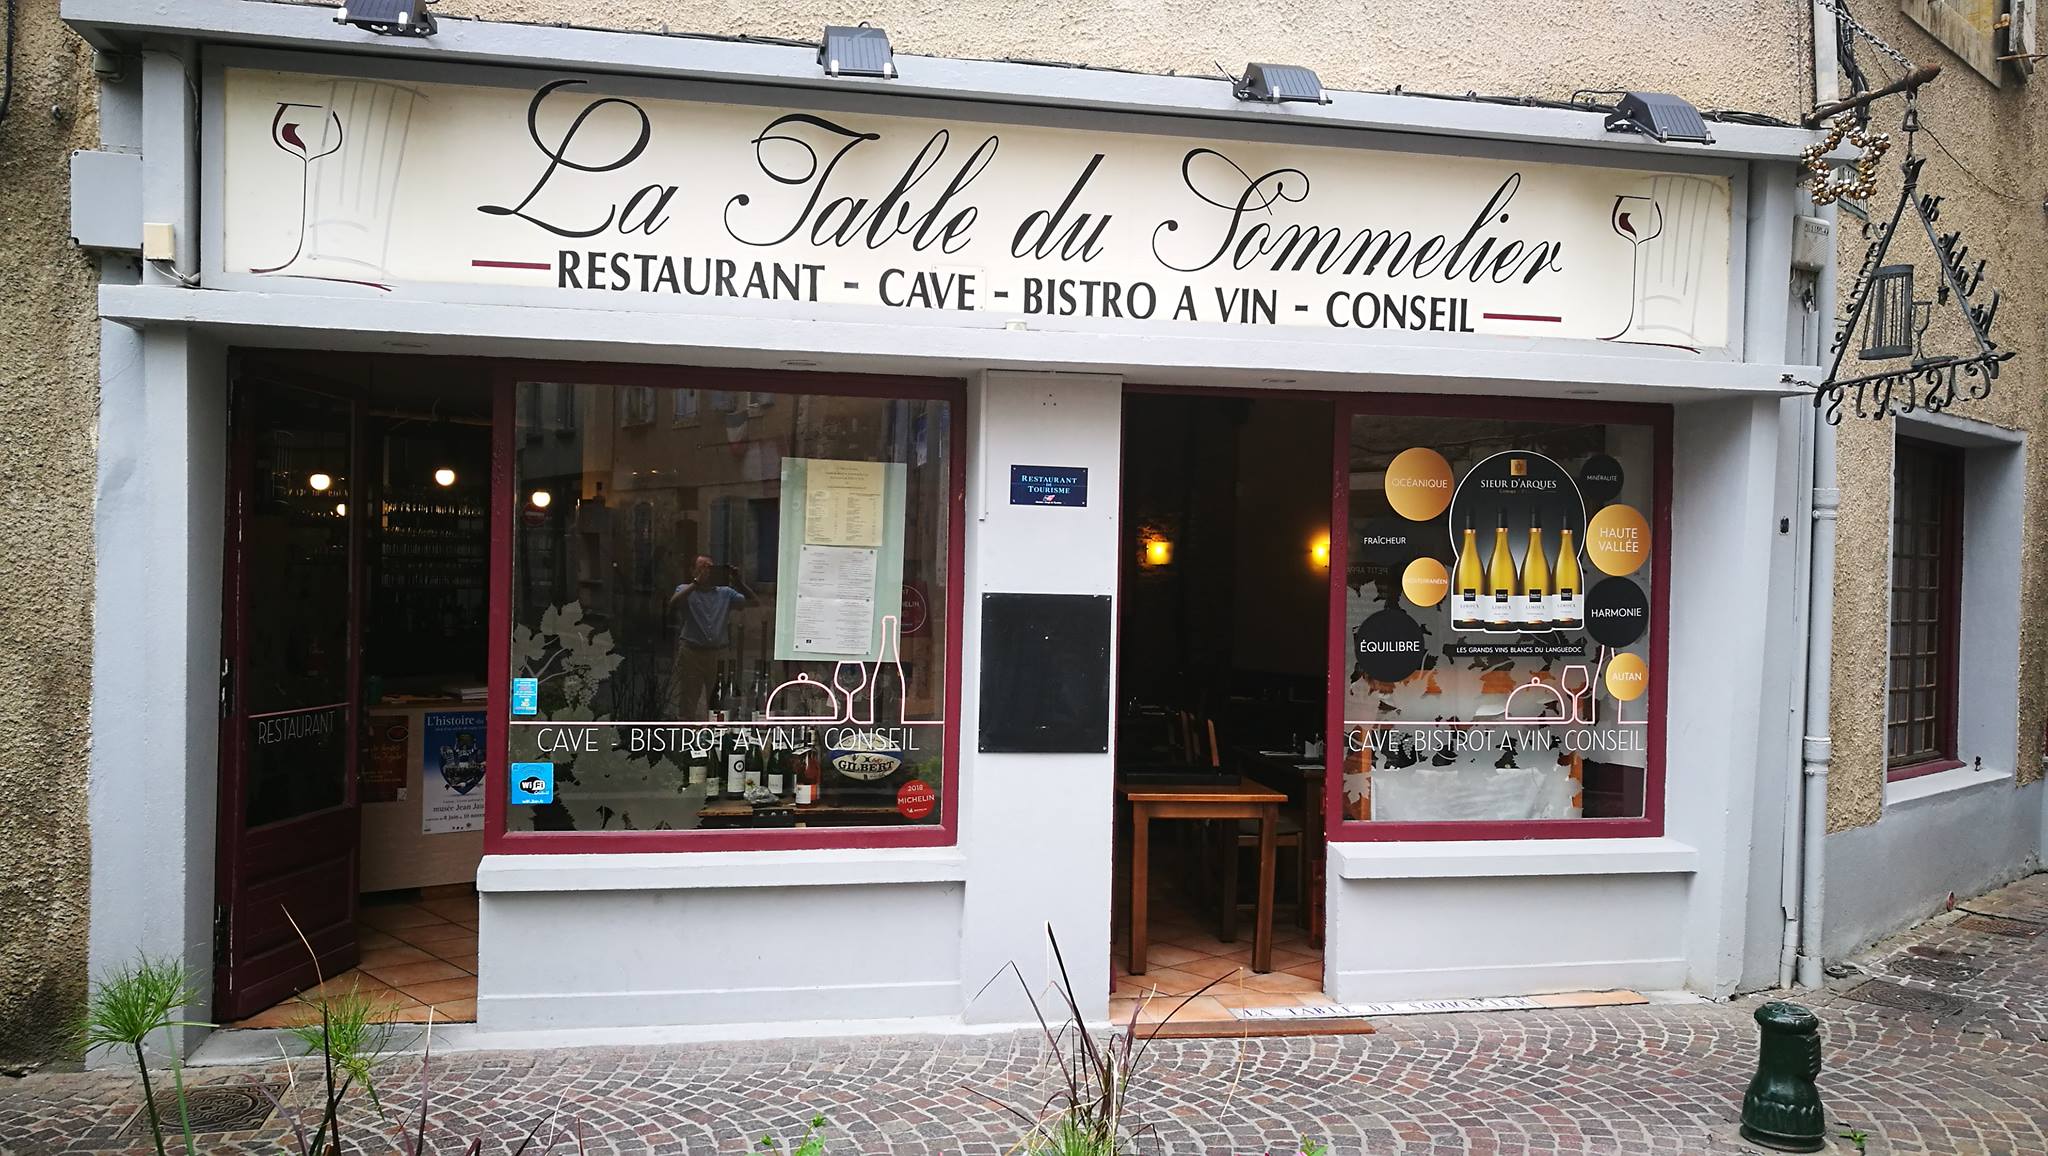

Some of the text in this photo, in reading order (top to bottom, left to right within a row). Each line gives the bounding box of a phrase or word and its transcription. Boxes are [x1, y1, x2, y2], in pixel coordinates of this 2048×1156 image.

[478, 80, 1562, 284] La Table du Sommelier
[558, 250, 825, 302] RESTAURANT
[879, 268, 975, 311] CAVE
[1023, 277, 1156, 320] BISTRO
[1173, 285, 1197, 321] A
[1215, 287, 1277, 325] VIN
[1326, 291, 1475, 333] CONSEIL
[1391, 476, 1448, 489] OCÉANIQUE
[1480, 478, 1558, 490] SIEUR D'ARQUES
[1027, 485, 1071, 494] TOURISME
[1600, 527, 1638, 539] HAUTE
[1363, 535, 1407, 545] FRAÎCHEUR
[1599, 540, 1639, 553] VALLÉE
[1591, 606, 1642, 618] HARMONIE
[1360, 639, 1420, 653] ÉQUILIBRE
[1611, 671, 1642, 682] AUTAN
[427, 714, 475, 727] L'histoire
[258, 710, 335, 745] RESTAURANT
[537, 728, 599, 752] CAVE
[631, 727, 728, 752] BISTROT
[733, 728, 749, 752] A
[755, 728, 795, 752] VIN
[824, 727, 920, 752] CONSEIL
[1348, 730, 1398, 752] CAVE
[1414, 729, 1495, 752] BISTROT
[1499, 730, 1513, 752] A
[1517, 730, 1550, 752] VIN
[1565, 729, 1644, 752] CONSEIL
[838, 759, 895, 773] GILBERT
[907, 784, 924, 792] 2018
[897, 794, 935, 805] MICHELIN
